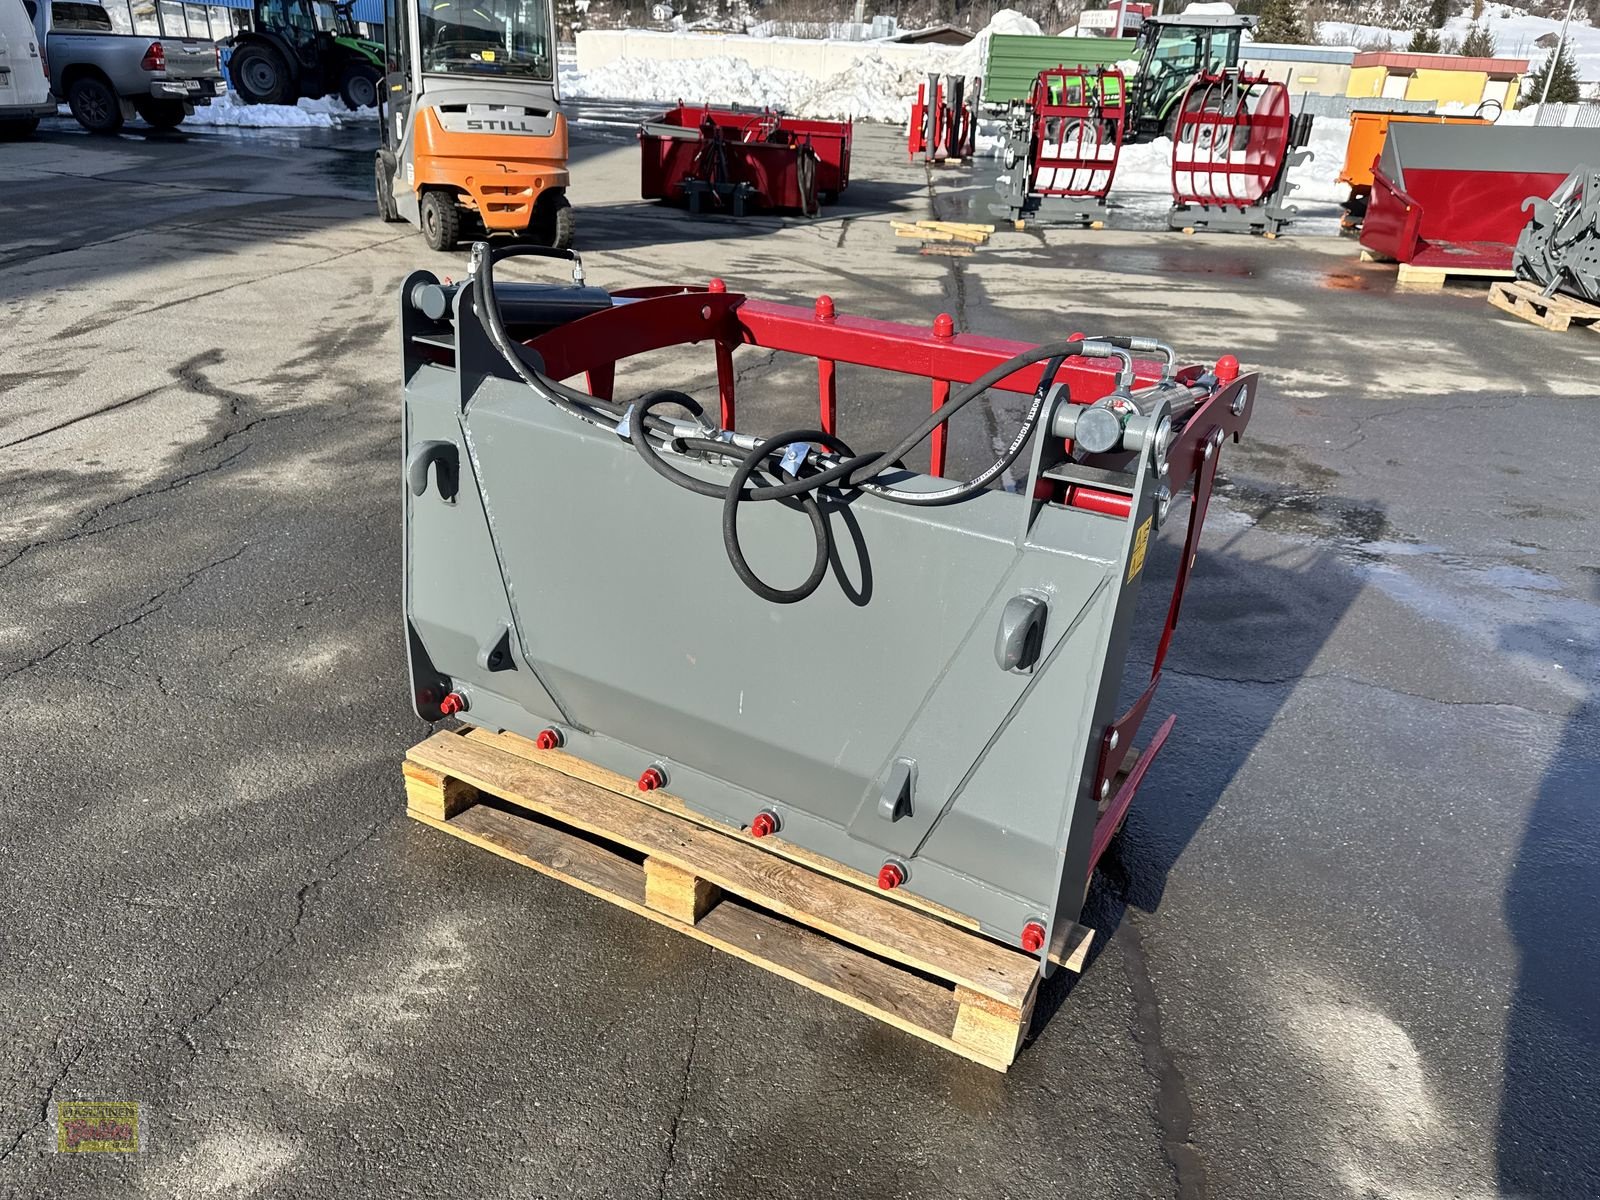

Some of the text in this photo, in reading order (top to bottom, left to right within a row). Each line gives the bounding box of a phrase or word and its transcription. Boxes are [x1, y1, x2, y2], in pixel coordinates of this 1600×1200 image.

[466, 120, 534, 133] STILL
[1009, 397, 1042, 453] NORTH FIGHTER
